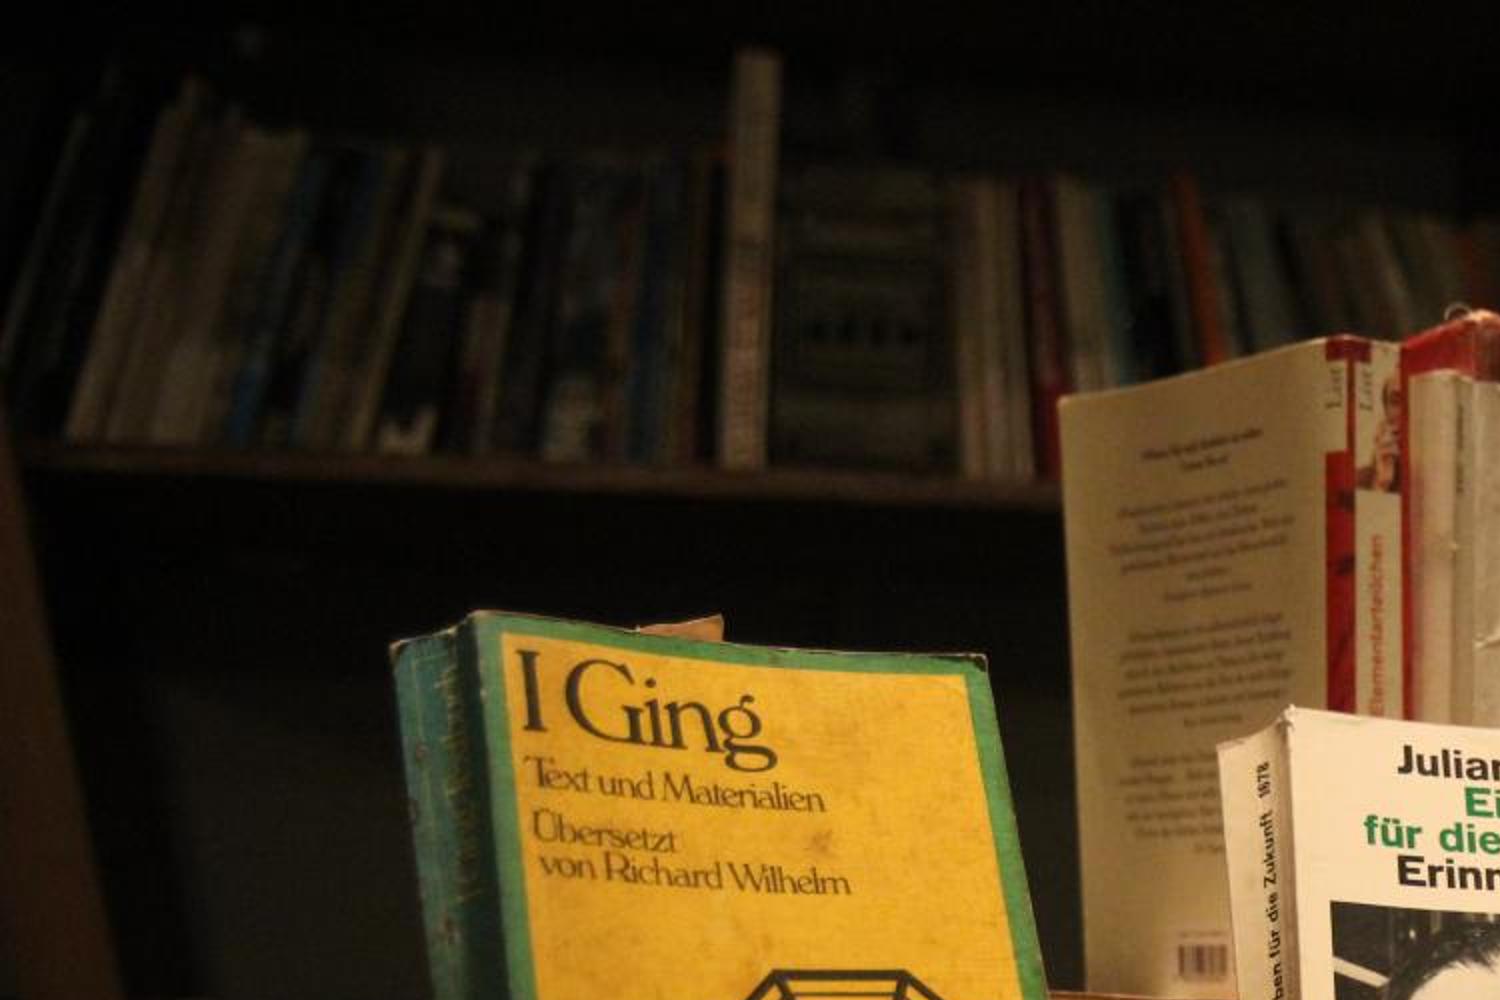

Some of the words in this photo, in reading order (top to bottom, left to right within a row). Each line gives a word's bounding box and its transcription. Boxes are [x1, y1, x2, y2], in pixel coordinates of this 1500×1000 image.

[516, 650, 548, 733] I
[564, 660, 777, 772] Ging
[525, 755, 591, 793] Text
[598, 771, 656, 800] und
[662, 772, 826, 813] Materialien
[1257, 762, 1272, 799] 1678
[532, 808, 678, 854] Übersetzt
[1259, 811, 1278, 888] Zukunft
[1363, 815, 1422, 849] für
[539, 856, 597, 881] von
[604, 851, 723, 890] Richard
[728, 862, 852, 896] Wilhelm
[1265, 892, 1281, 924] die
[1268, 930, 1281, 959] für
